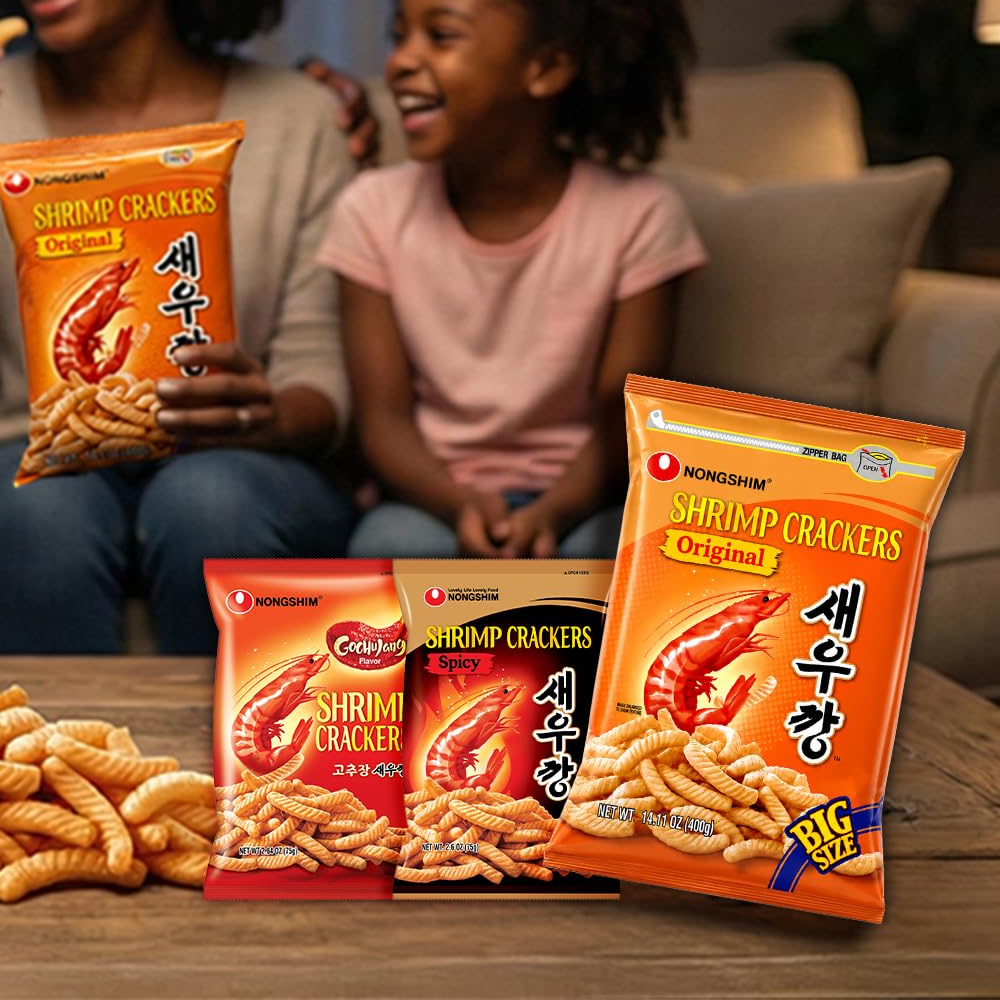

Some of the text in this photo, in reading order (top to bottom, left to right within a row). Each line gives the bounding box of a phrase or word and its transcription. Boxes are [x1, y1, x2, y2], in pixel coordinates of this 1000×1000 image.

[33, 186, 216, 231] SHRIMP CRACKERS
[44, 231, 113, 254] Original
[801, 447, 848, 463] ZIPPER BAG
[862, 464, 879, 473] OPEN
[669, 491, 903, 561] SHRIMP CRACKERS
[676, 535, 765, 567] Original
[447, 593, 499, 602] NONGSHIM
[424, 625, 593, 650] SHRIMP CRACKERS
[359, 657, 382, 666] Flavor
[438, 654, 481, 673] Spicy
[786, 581, 862, 761] 새우깡
[315, 724, 403, 752] CRACKER
[534, 670, 577, 798] 새우깡
[332, 763, 371, 777] 고추장
[597, 803, 715, 837] NET WT 14.11 OZ (400g)
[788, 799, 853, 855] BIG
[422, 843, 433, 851] NET
[811, 832, 858, 871] SIZE
